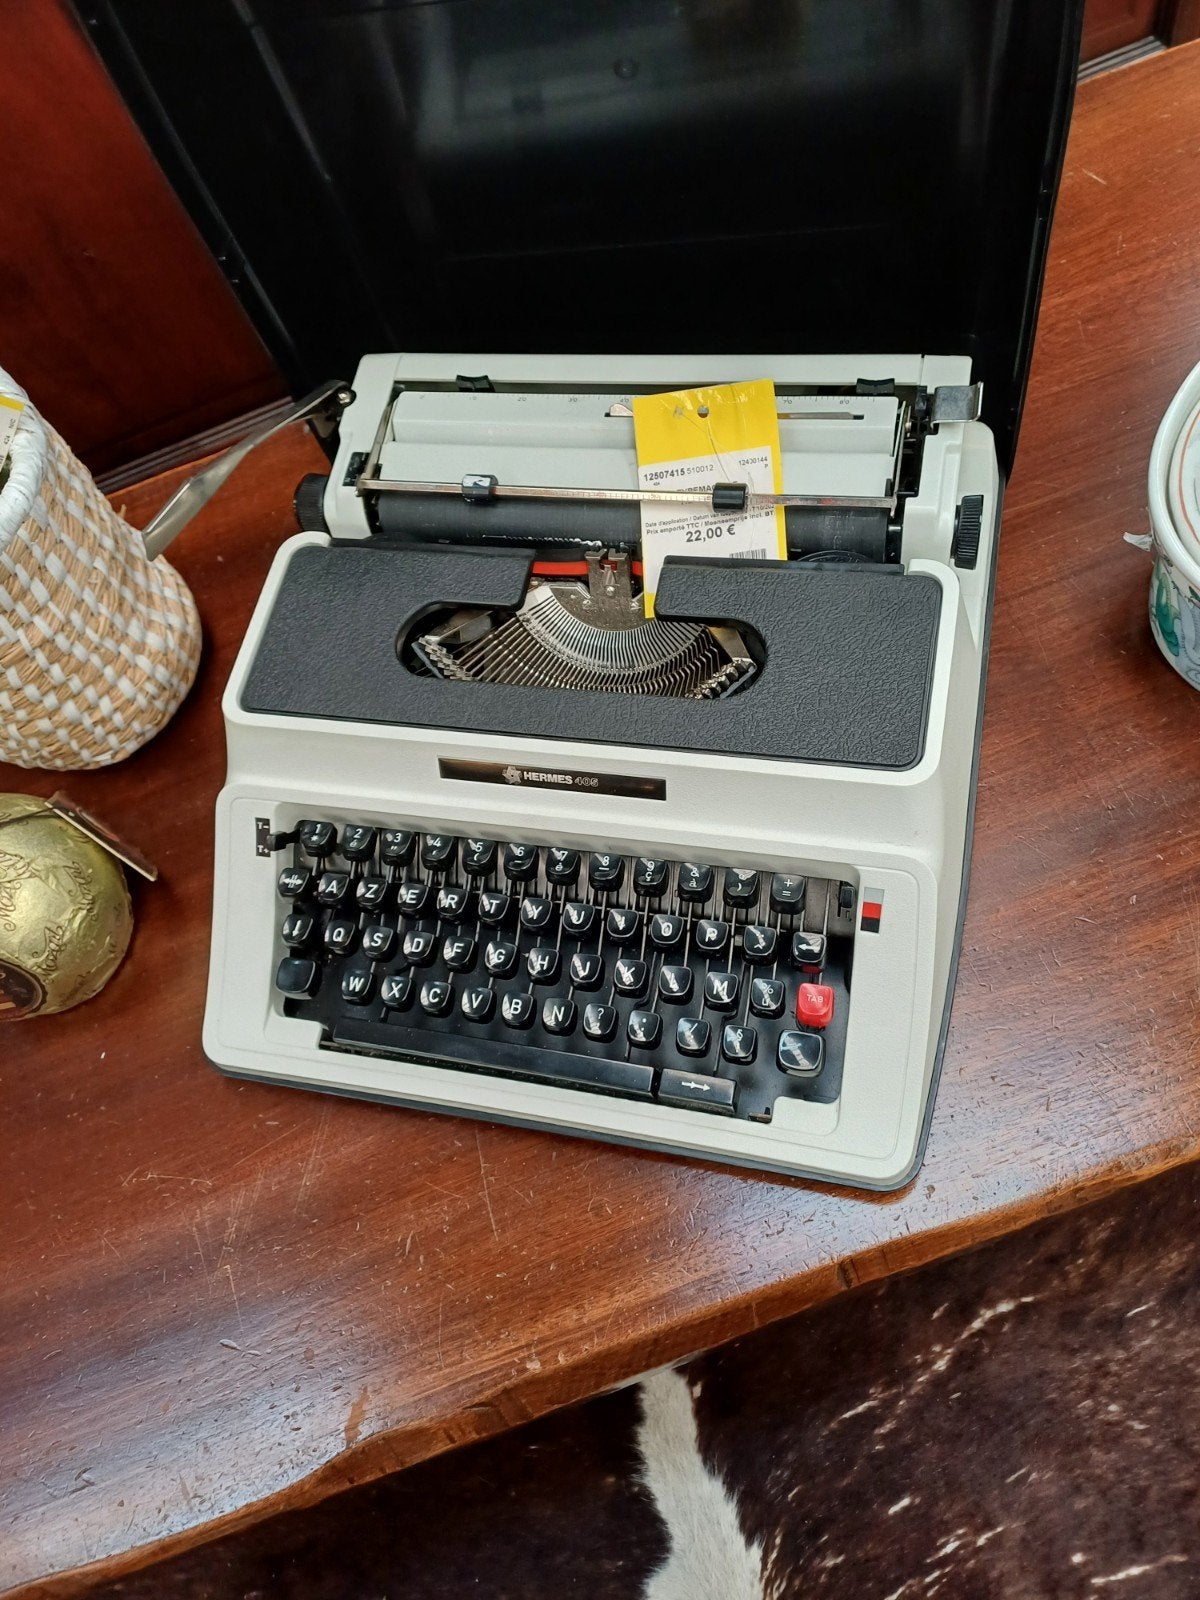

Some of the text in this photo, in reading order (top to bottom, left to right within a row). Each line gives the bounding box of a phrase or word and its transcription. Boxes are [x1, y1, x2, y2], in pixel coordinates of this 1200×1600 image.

[644, 468, 686, 482] 12507415
[686, 464, 714, 475] 510012
[686, 524, 736, 543] 22,00 €
[523, 771, 573, 785] HERMES
[316, 823, 322, 834] 1
[355, 828, 364, 838] 2
[394, 832, 402, 842] 3
[432, 836, 442, 847] 4
[475, 842, 484, 852] 5
[516, 846, 524, 856] 6
[560, 850, 568, 861] 7
[602, 855, 610, 866] 8
[648, 860, 654, 872] 9
[690, 867, 700, 878] &
[324, 880, 337, 894] A
[364, 884, 379, 898] Z
[406, 890, 420, 904] E
[445, 894, 458, 908] R
[489, 900, 500, 914] T
[532, 906, 543, 920] Y
[572, 910, 585, 924] U
[661, 922, 672, 936] O
[705, 928, 718, 942] P
[332, 927, 344, 942] Q
[370, 932, 384, 946] S
[411, 938, 424, 952] D
[452, 942, 464, 956] F
[494, 948, 506, 963] G
[536, 955, 550, 970] H
[624, 966, 636, 983] K
[713, 980, 728, 995] M
[348, 976, 365, 992] W
[388, 982, 404, 998] X
[428, 988, 441, 1003] C
[472, 994, 484, 1009] V
[510, 998, 522, 1014] B
[551, 1005, 565, 1022] N
[598, 1008, 604, 1020] ?
[806, 993, 824, 1003] TAB
